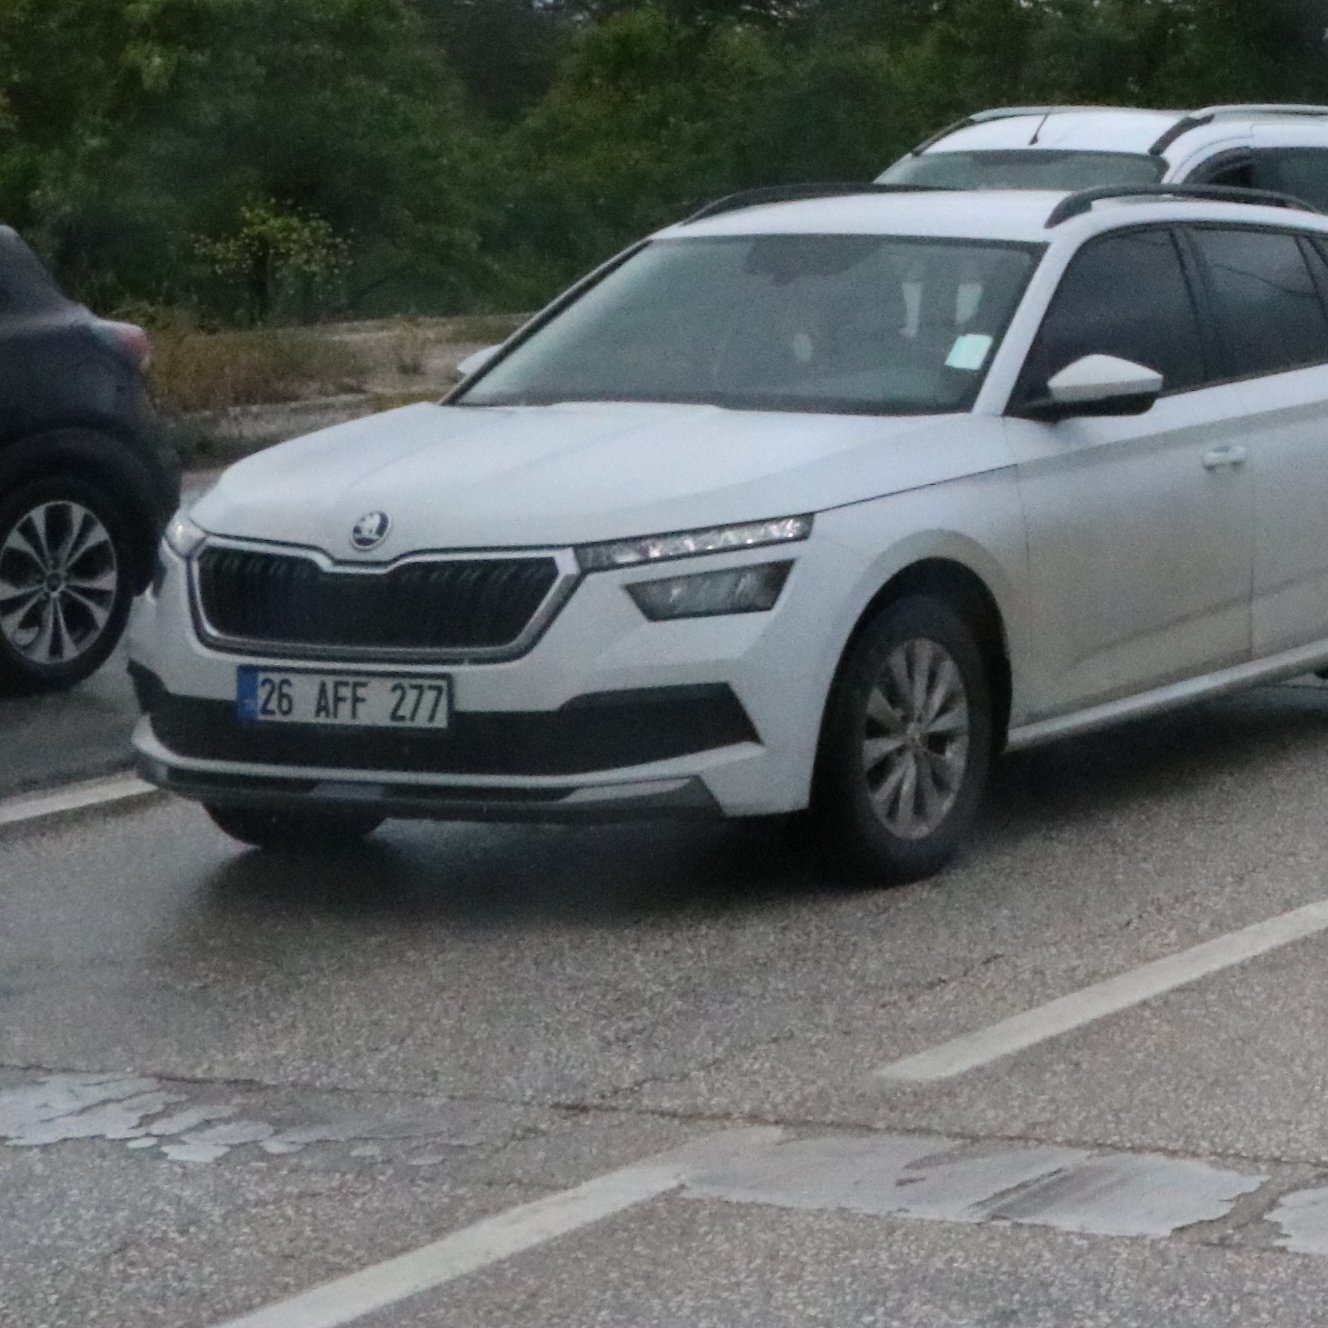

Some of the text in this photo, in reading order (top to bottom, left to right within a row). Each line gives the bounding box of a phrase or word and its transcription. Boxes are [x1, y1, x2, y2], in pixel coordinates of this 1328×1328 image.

[260, 677, 444, 723] 26 AFF 277
